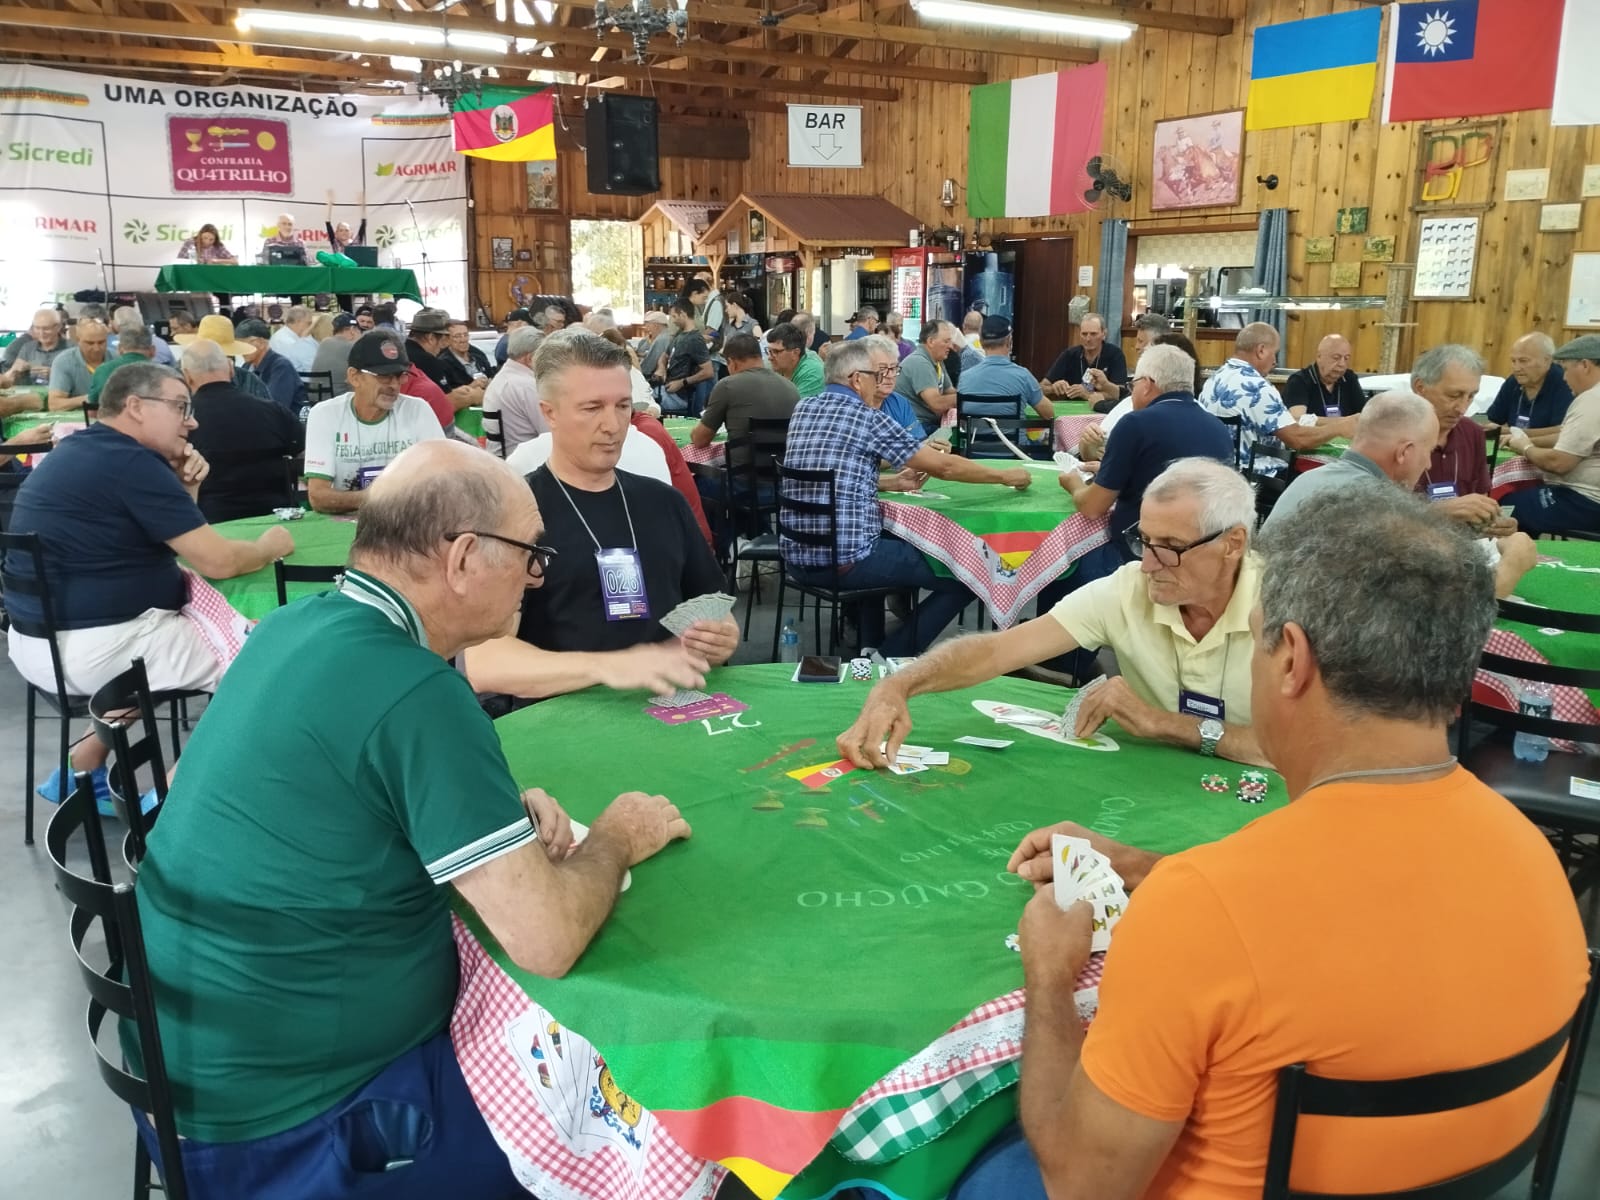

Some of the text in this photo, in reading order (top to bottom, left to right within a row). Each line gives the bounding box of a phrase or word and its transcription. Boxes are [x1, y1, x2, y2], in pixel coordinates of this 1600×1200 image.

[104, 83, 358, 119] UMA ORGANIZAÇÃO
[805, 112, 846, 130] BAR
[8, 142, 94, 166] Sicredi
[200, 157, 264, 166] CONFRARIA
[176, 168, 288, 184] QU4TRILHO
[394, 160, 457, 177] AGRIMAR
[35, 216, 97, 233] RIMAR
[606, 569, 639, 594] 026
[701, 712, 762, 736] 27
[796, 880, 990, 909] GAÚCHO
